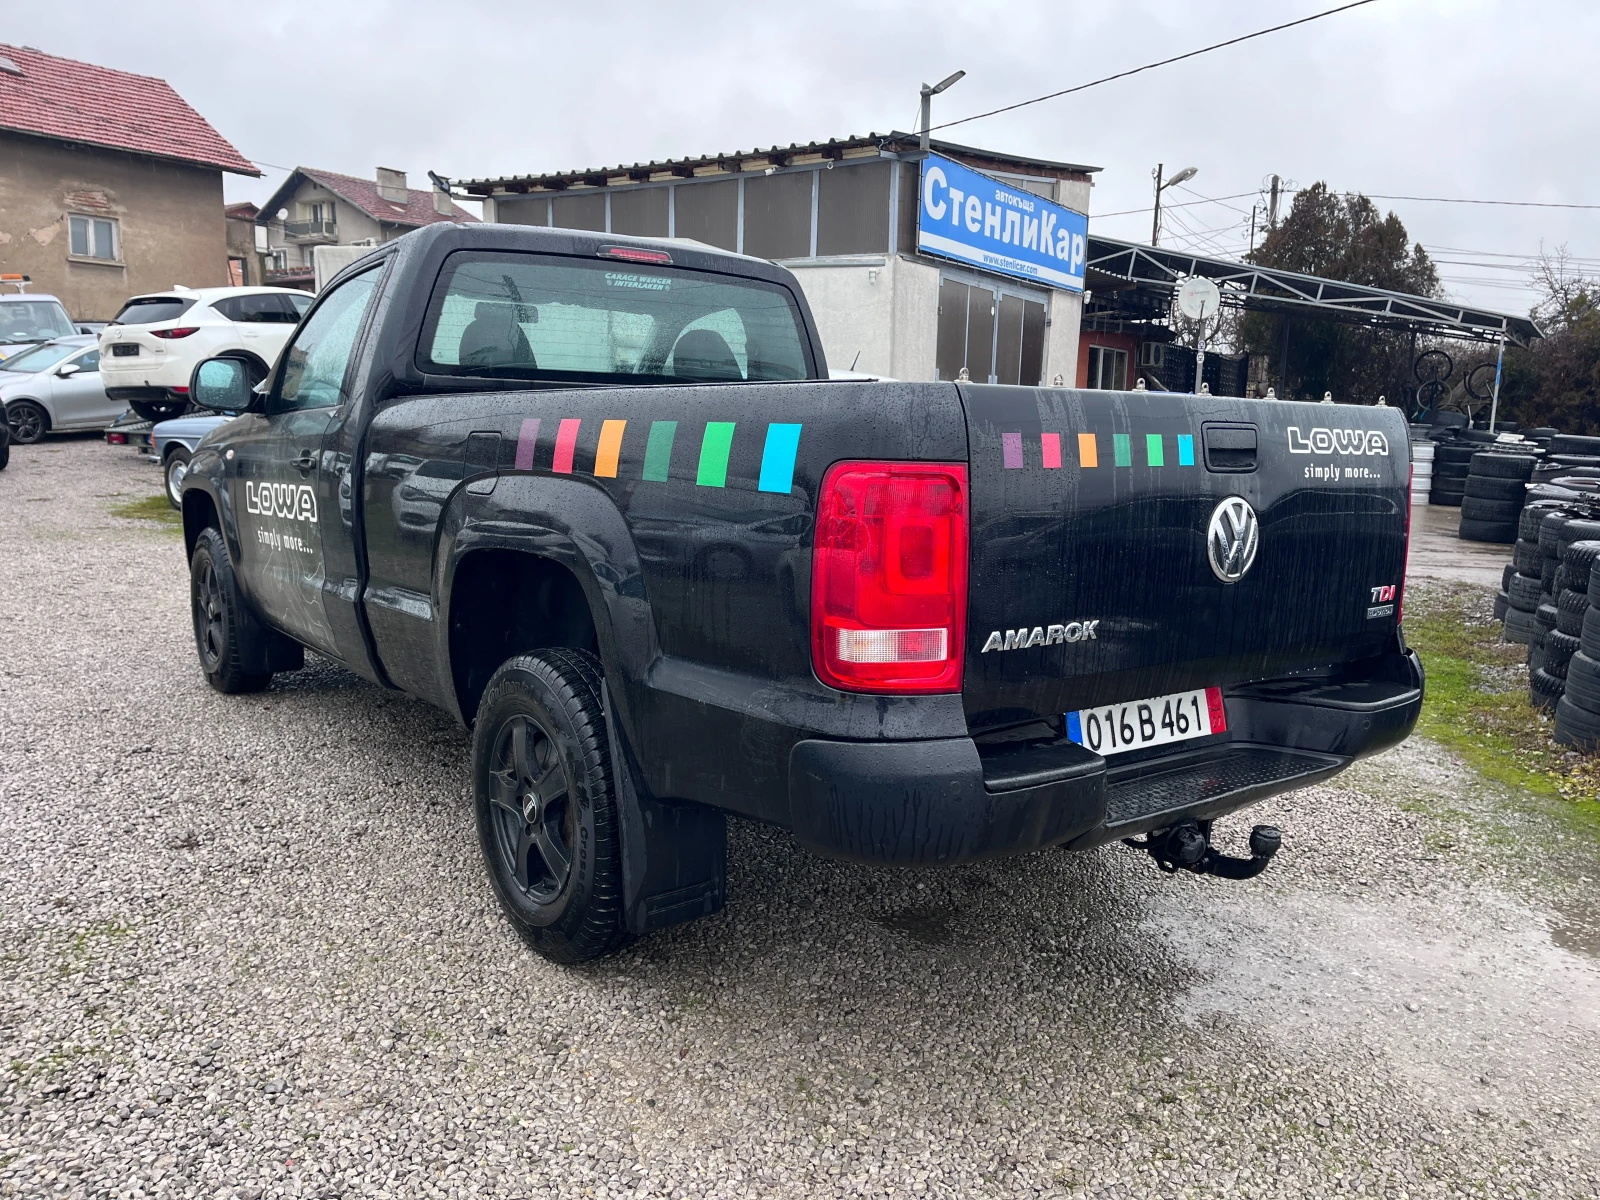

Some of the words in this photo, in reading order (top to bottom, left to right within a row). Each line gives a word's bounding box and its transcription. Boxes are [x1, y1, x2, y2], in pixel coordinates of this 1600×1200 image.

[995, 189, 1035, 213] автокъща
[924, 166, 1084, 274] СтенлиКар
[983, 254, 1038, 275] www.stenlicar.com
[614, 280, 664, 290] INTERLAKEN
[1287, 426, 1389, 455] LOWA
[1304, 463, 1340, 482] simply
[1344, 467, 1381, 479] more...
[246, 481, 317, 522] LOWA
[257, 526, 281, 551] simply
[283, 535, 313, 554] more...
[1371, 584, 1396, 603] TDI
[981, 619, 1100, 653] AMAROK
